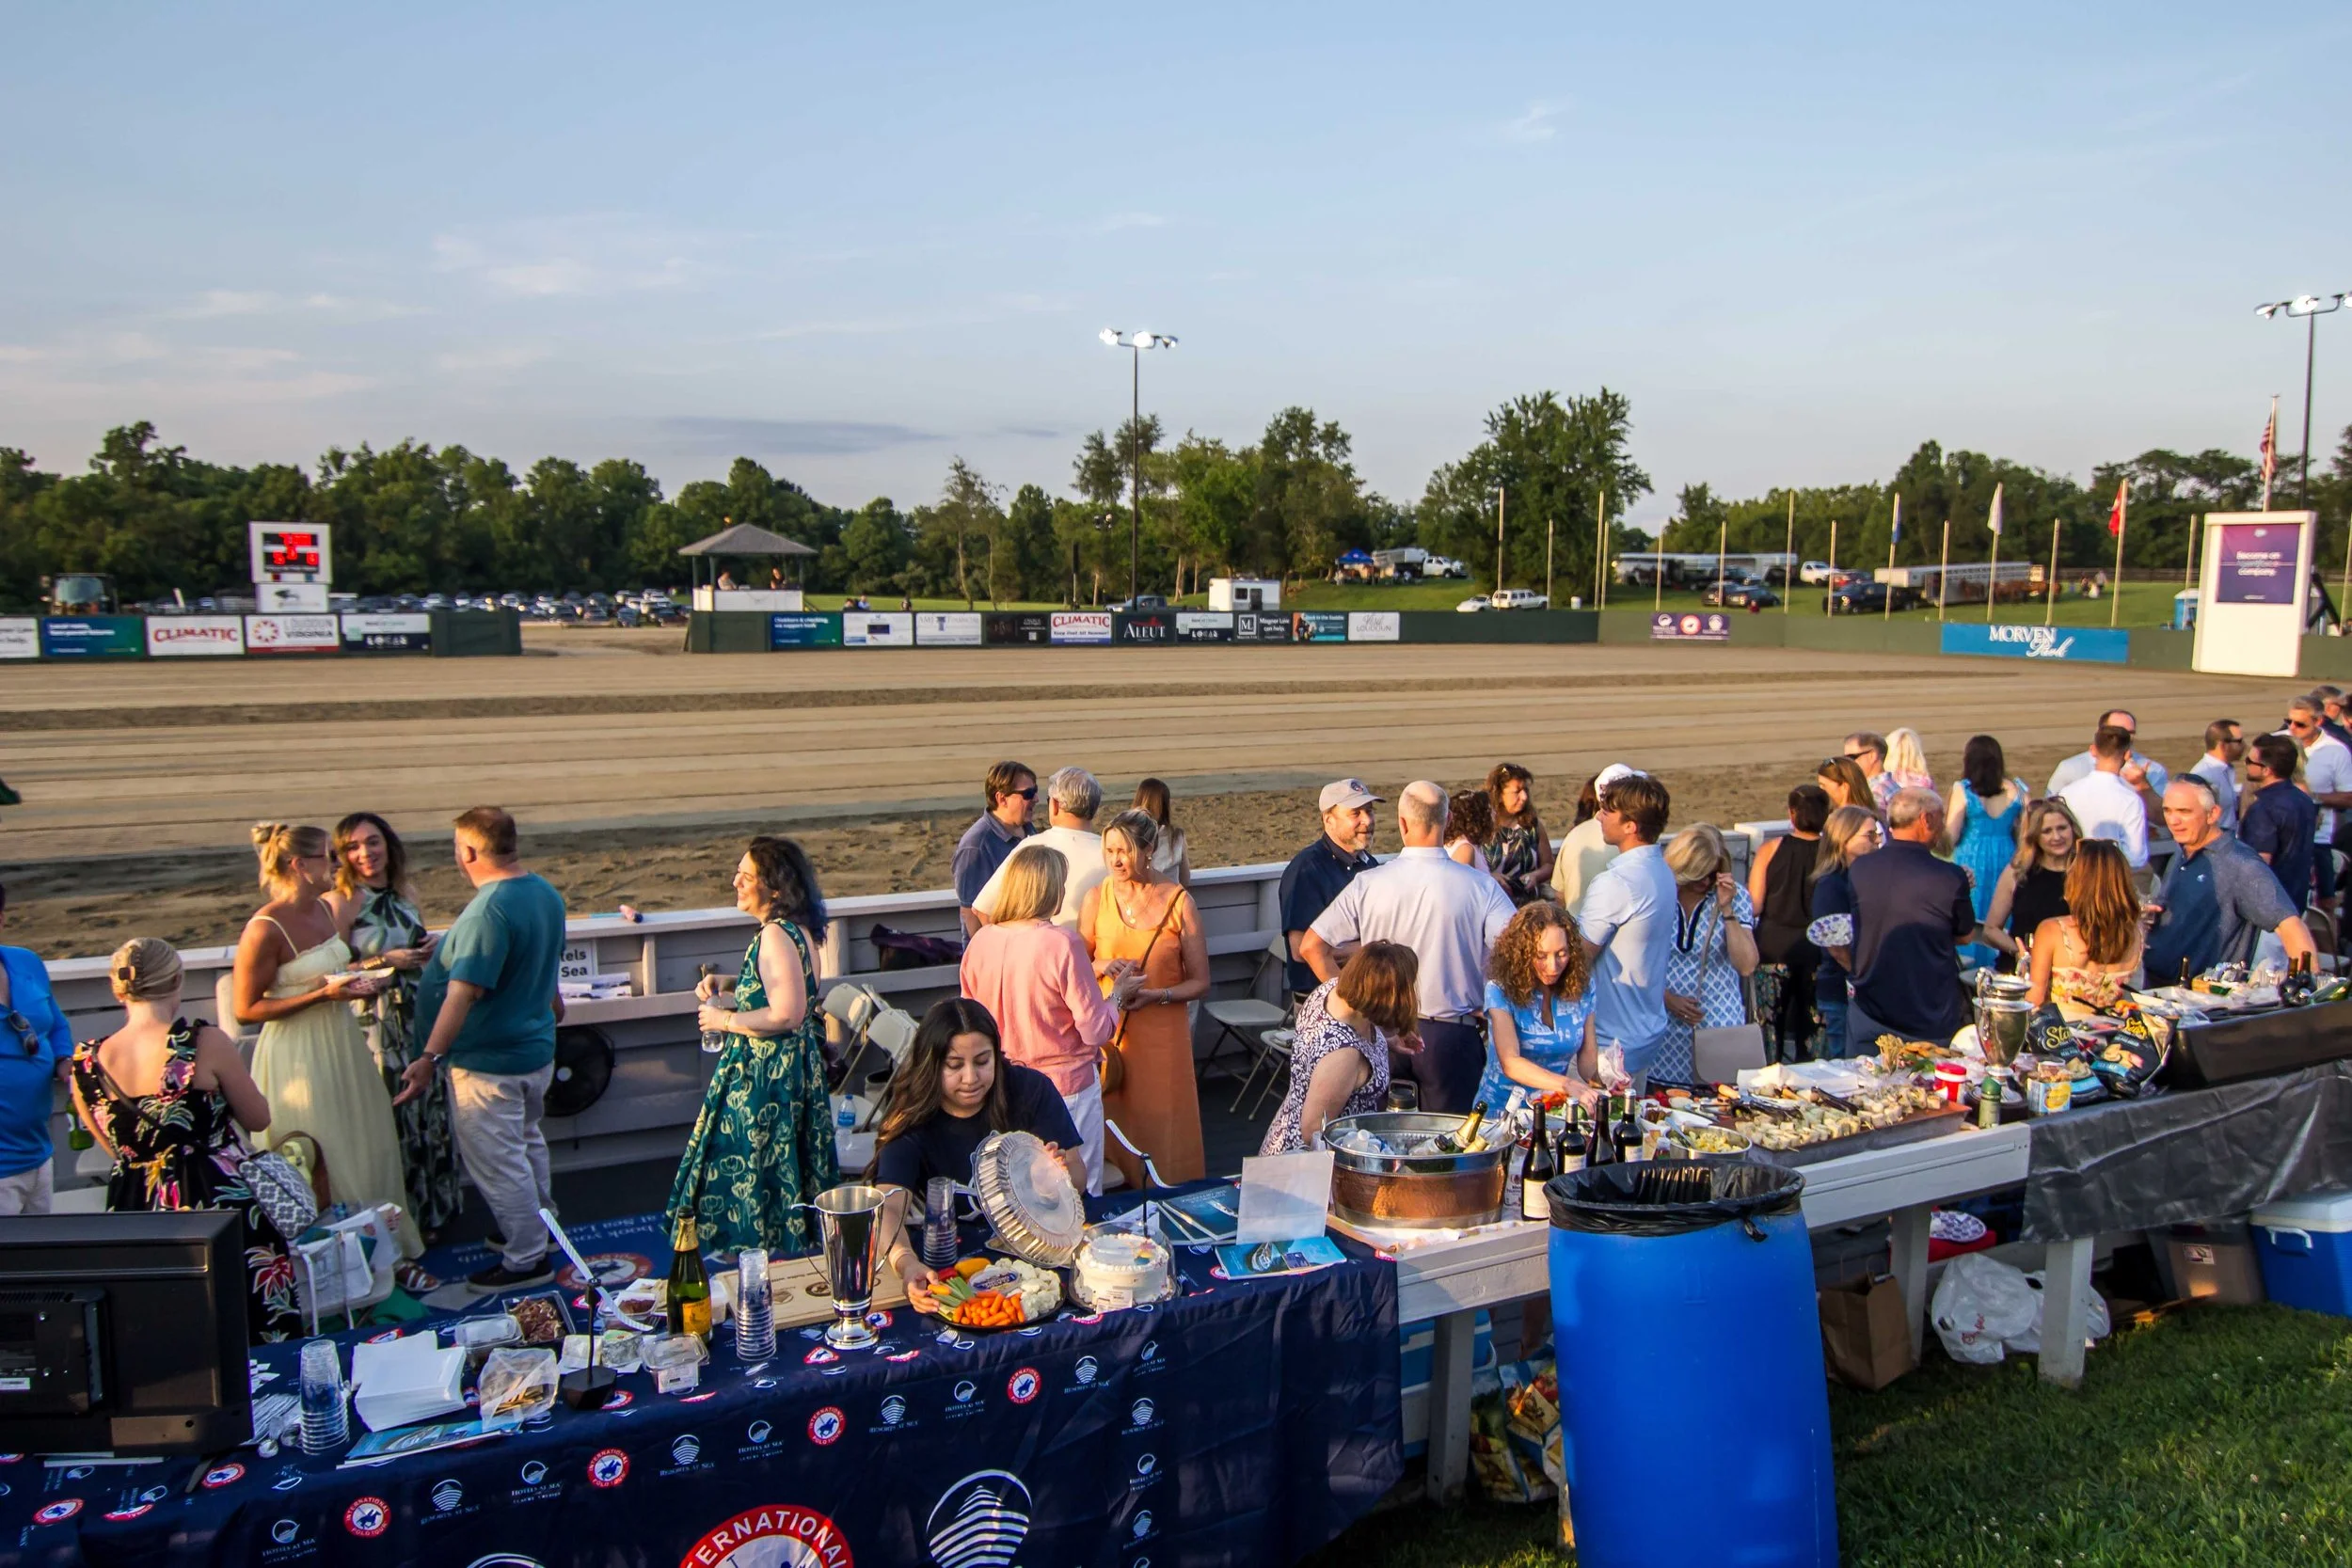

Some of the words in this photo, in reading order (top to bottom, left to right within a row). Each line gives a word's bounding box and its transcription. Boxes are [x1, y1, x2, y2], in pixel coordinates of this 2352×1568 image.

[1053, 616, 1110, 627] CLIMATIC
[153, 627, 238, 642] CLIMATIC
[285, 629, 333, 639] VIRGINIA
[1124, 622, 1166, 638] ALEUT
[1989, 625, 2058, 643] MORVEN
[2026, 636, 2075, 657] Park
[561, 966, 588, 977] Sea
[608, 1224, 655, 1239] book
[1008, 1367, 1040, 1389] INTERNATIONAL
[809, 1406, 844, 1429] INTERNATIONAL
[812, 1435, 827, 1445] POLO
[590, 1449, 628, 1471] INTERNATIONAL
[346, 1497, 389, 1521] INTERNATIONAL
[351, 1528, 371, 1536] POLO
